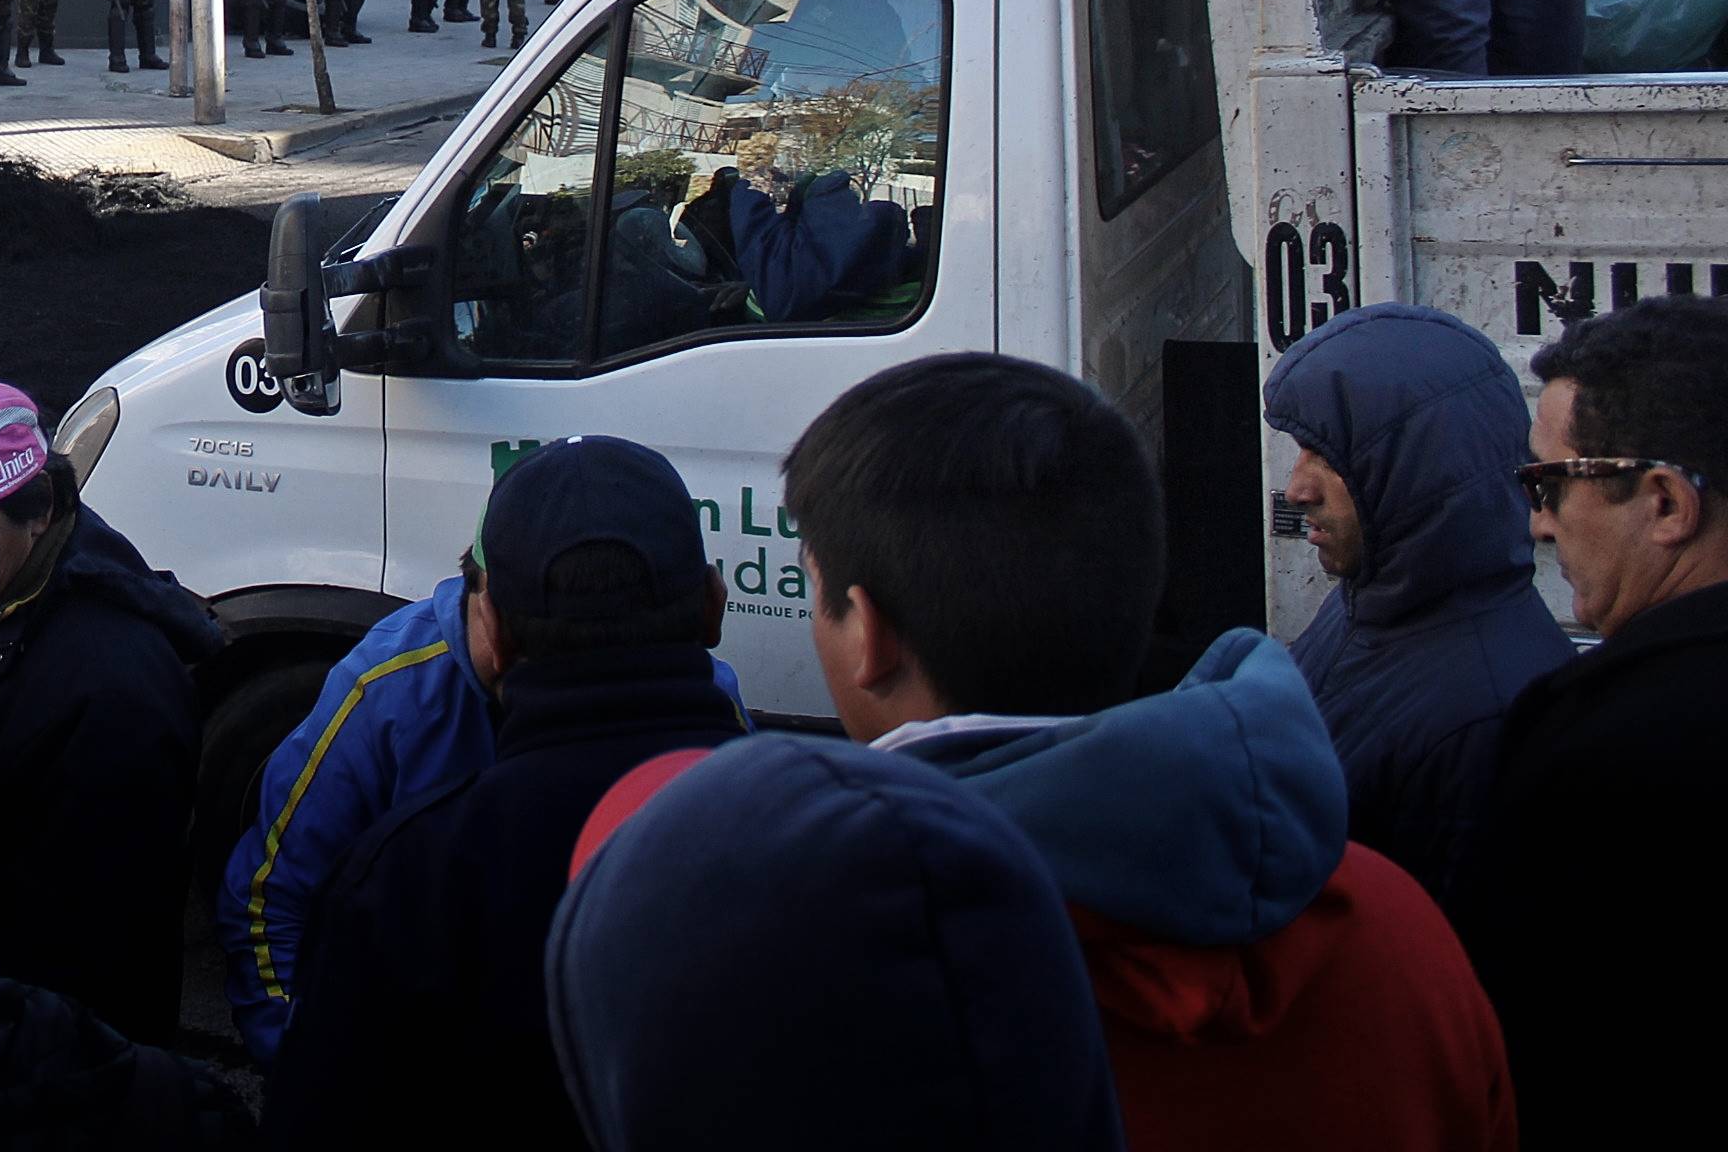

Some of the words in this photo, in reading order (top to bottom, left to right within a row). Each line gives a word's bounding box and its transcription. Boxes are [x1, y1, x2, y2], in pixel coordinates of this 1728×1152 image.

[1265, 221, 1350, 355] 03
[187, 466, 281, 493] DAILY
[727, 600, 793, 619] ENRIQUE
